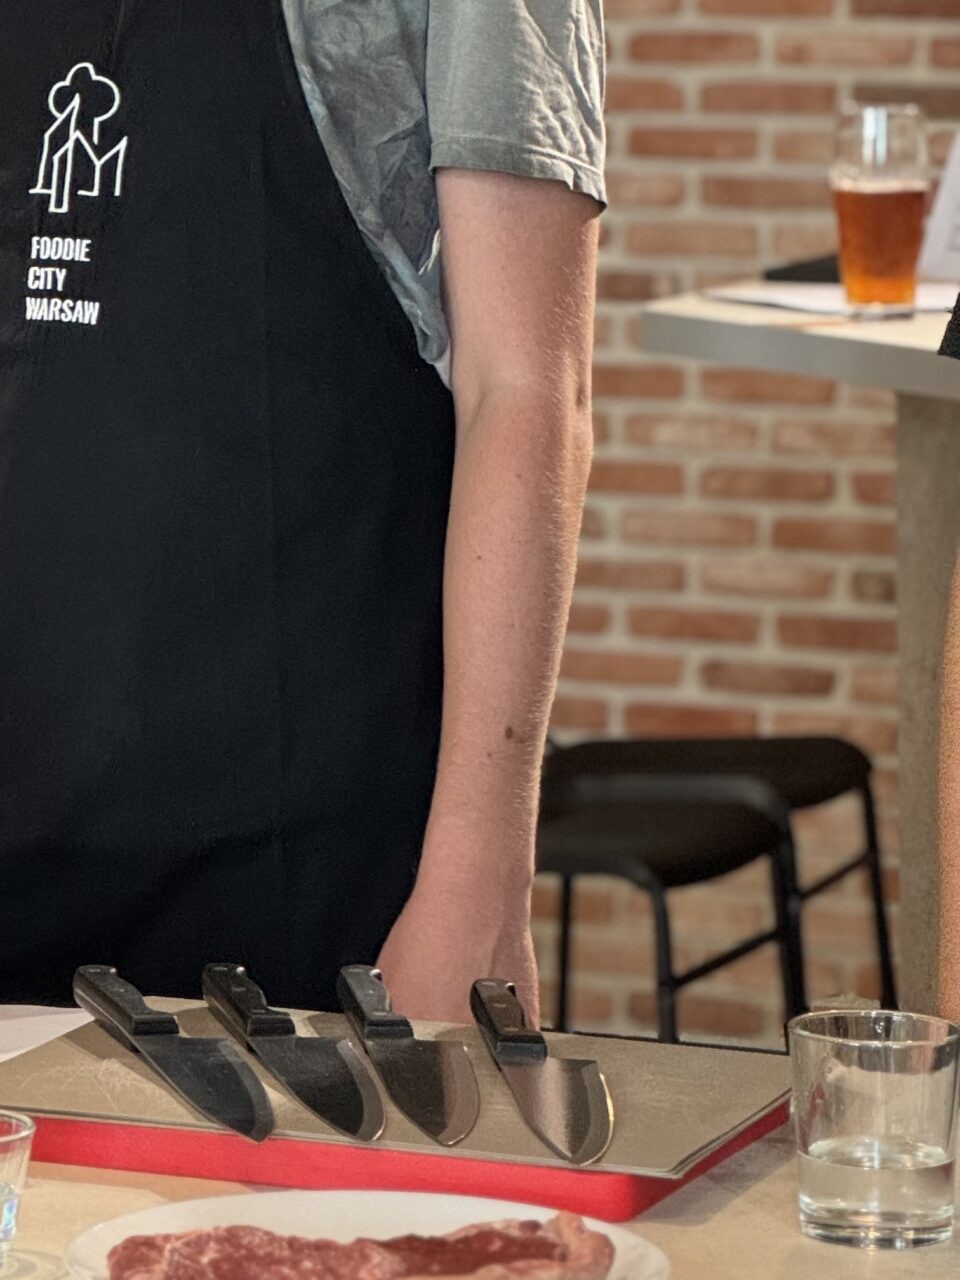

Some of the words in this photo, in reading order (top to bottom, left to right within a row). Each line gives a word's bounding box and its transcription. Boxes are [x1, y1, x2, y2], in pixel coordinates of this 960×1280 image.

[30, 236, 92, 262] FOODIE
[27, 266, 67, 292] CITY
[25, 296, 100, 326] WARSAW
